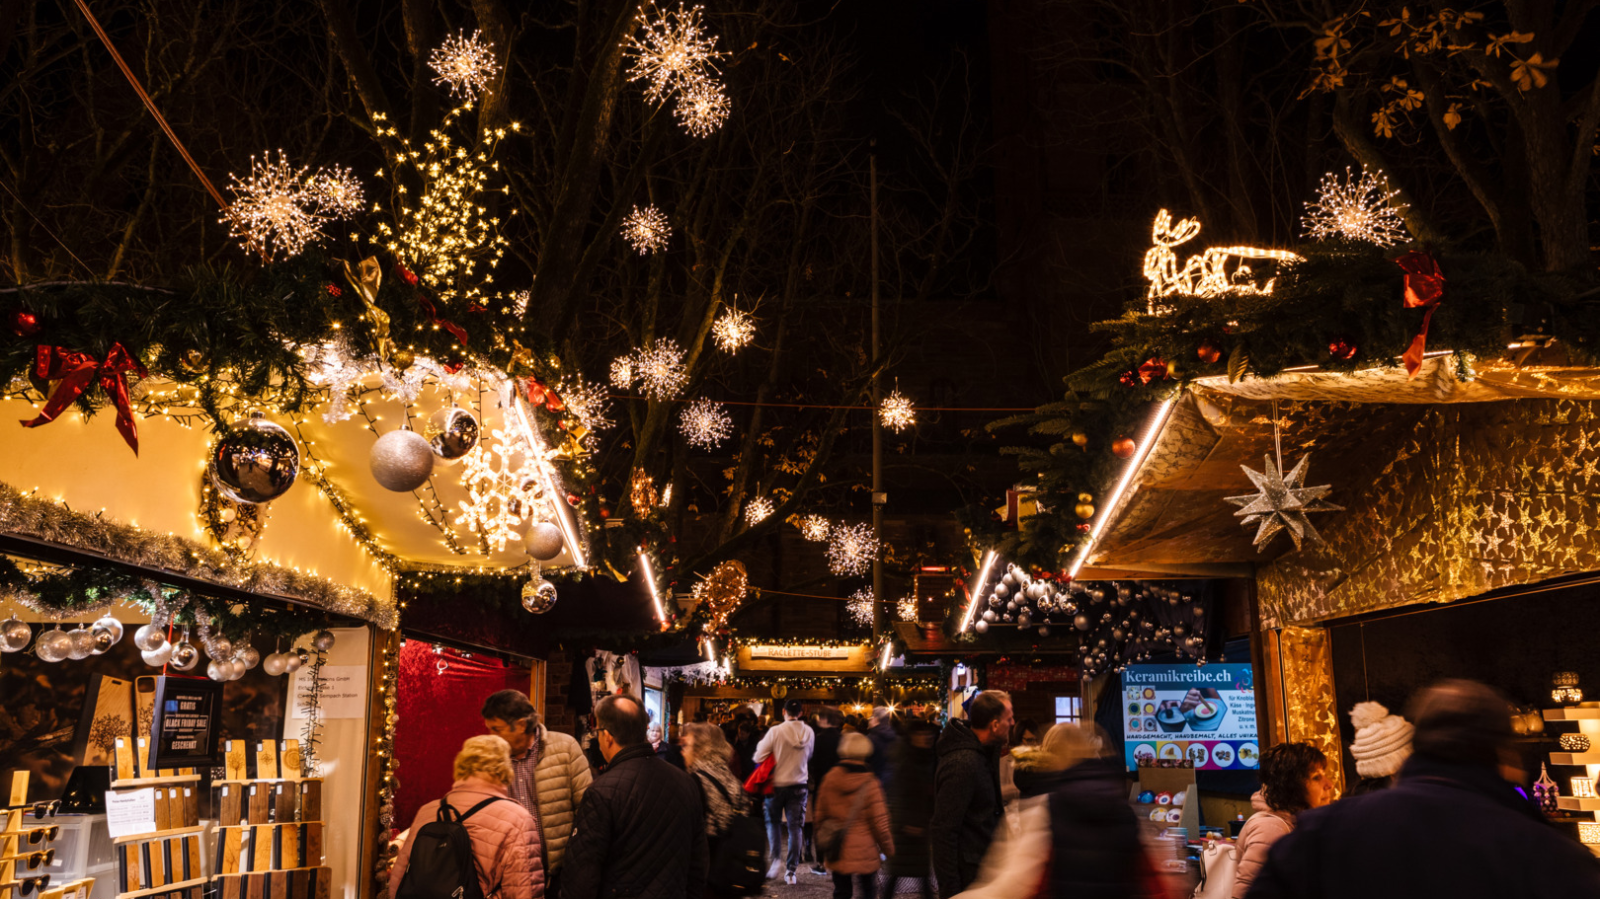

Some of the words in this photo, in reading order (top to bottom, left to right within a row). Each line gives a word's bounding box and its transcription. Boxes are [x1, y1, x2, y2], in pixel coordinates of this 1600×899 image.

[767, 647, 832, 657] RACLETTE-STUBE
[1125, 669, 1232, 683] Keramikreibe.ch
[180, 701, 197, 710] GRATIS
[165, 718, 181, 728] BLACK
[180, 718, 197, 728] FRIDAY
[196, 718, 208, 728] SALE
[171, 740, 198, 750] GESCHENKT
